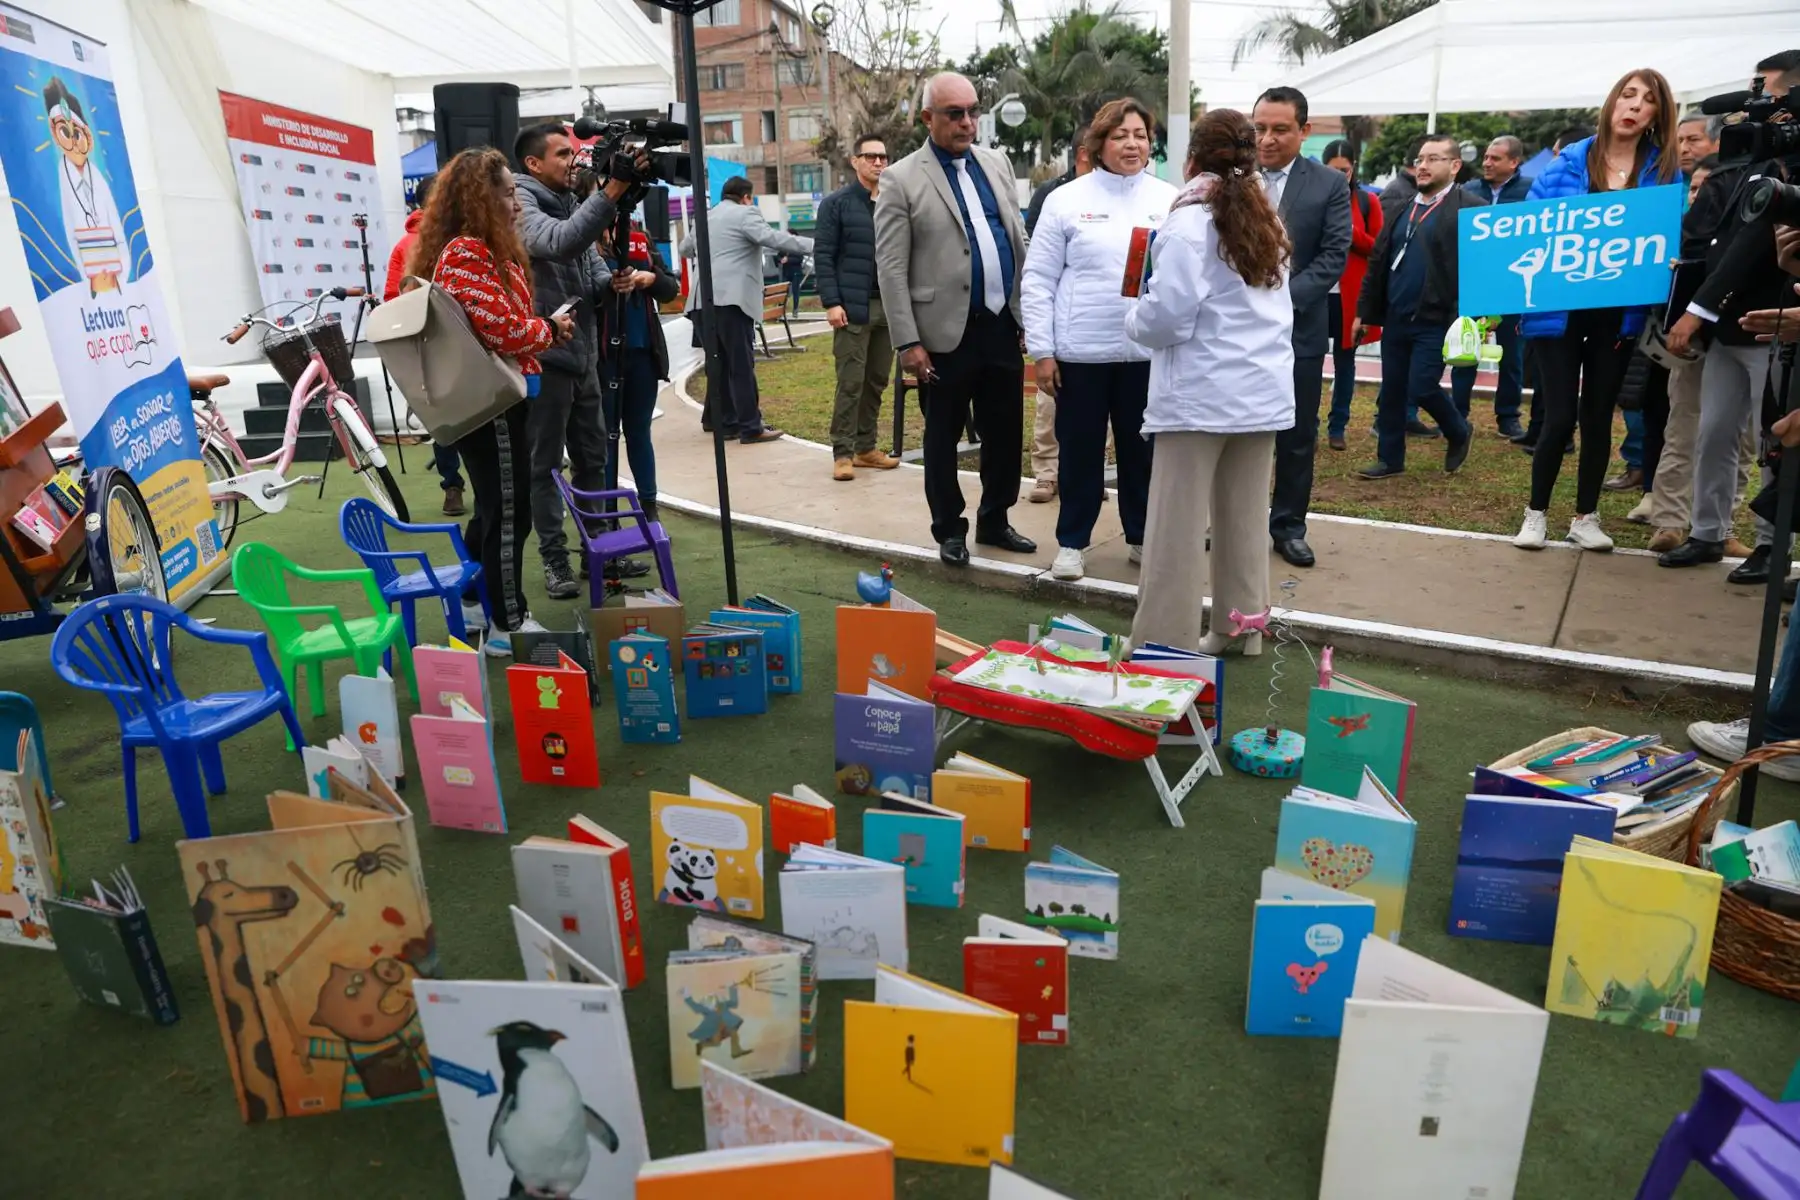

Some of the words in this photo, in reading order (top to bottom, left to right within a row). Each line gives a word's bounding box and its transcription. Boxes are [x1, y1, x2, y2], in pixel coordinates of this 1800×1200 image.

[262, 113, 300, 132] MINISTERIO
[300, 124, 311, 135] DE
[311, 125, 349, 144] DESARROLLO
[278, 133, 284, 144] E
[285, 134, 319, 151] INCLUSIÓN
[319, 141, 340, 155] SOCIAL
[1470, 202, 1626, 241] Sentirse
[1551, 233, 1666, 282] Bien
[80, 306, 125, 332] Lectura
[86, 336, 107, 364] que
[110, 416, 131, 449] LEER
[137, 394, 171, 425] SOÑAR
[128, 434, 152, 471] OJOS
[149, 414, 183, 456] ABIERTOS
[865, 705, 901, 721] Conoce
